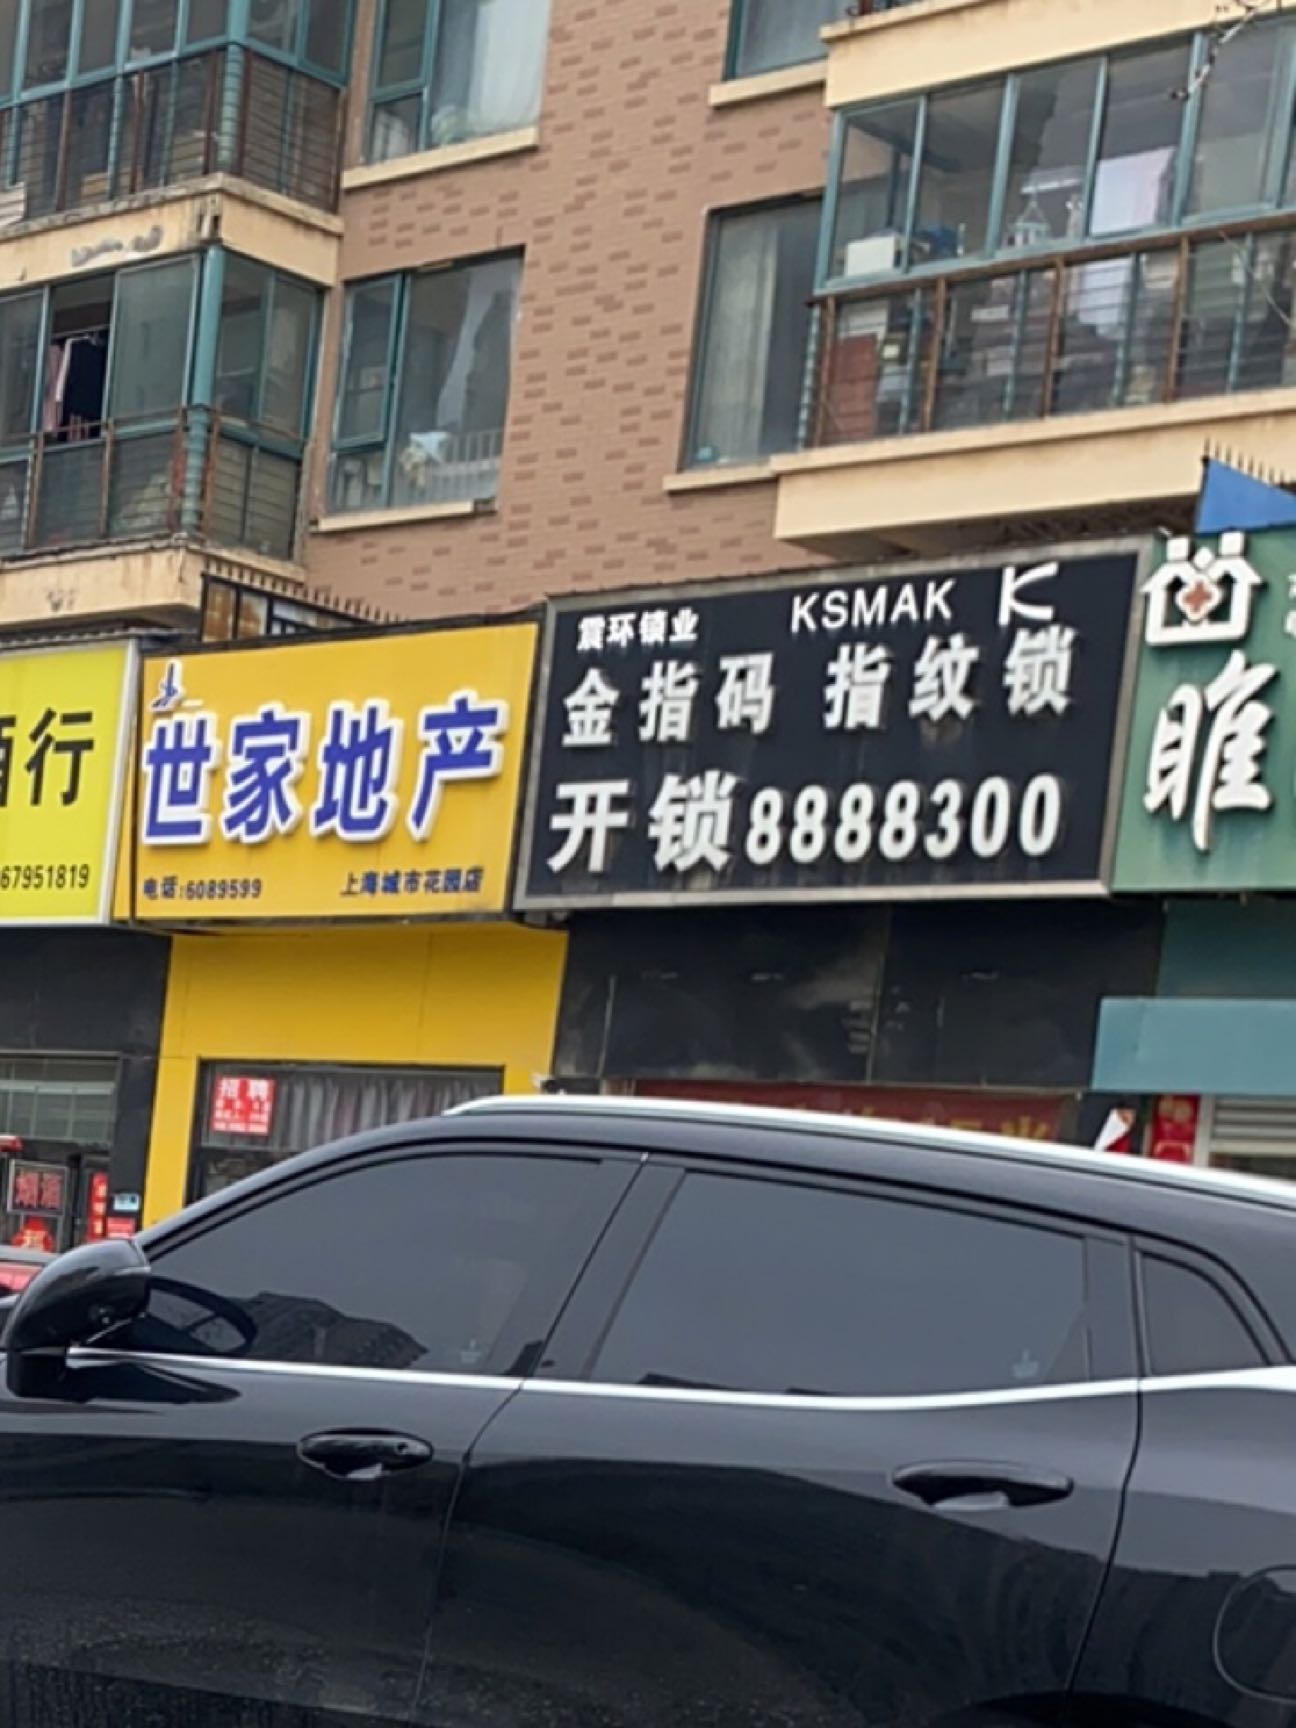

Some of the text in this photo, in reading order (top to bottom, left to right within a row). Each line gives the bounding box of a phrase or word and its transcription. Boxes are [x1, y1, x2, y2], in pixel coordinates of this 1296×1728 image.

[791, 579, 957, 633] KSMAK
[562, 625, 1076, 748] 金指码 指纹锁
[141, 686, 510, 850] 世家地产
[546, 767, 1062, 875] 开锁8888300
